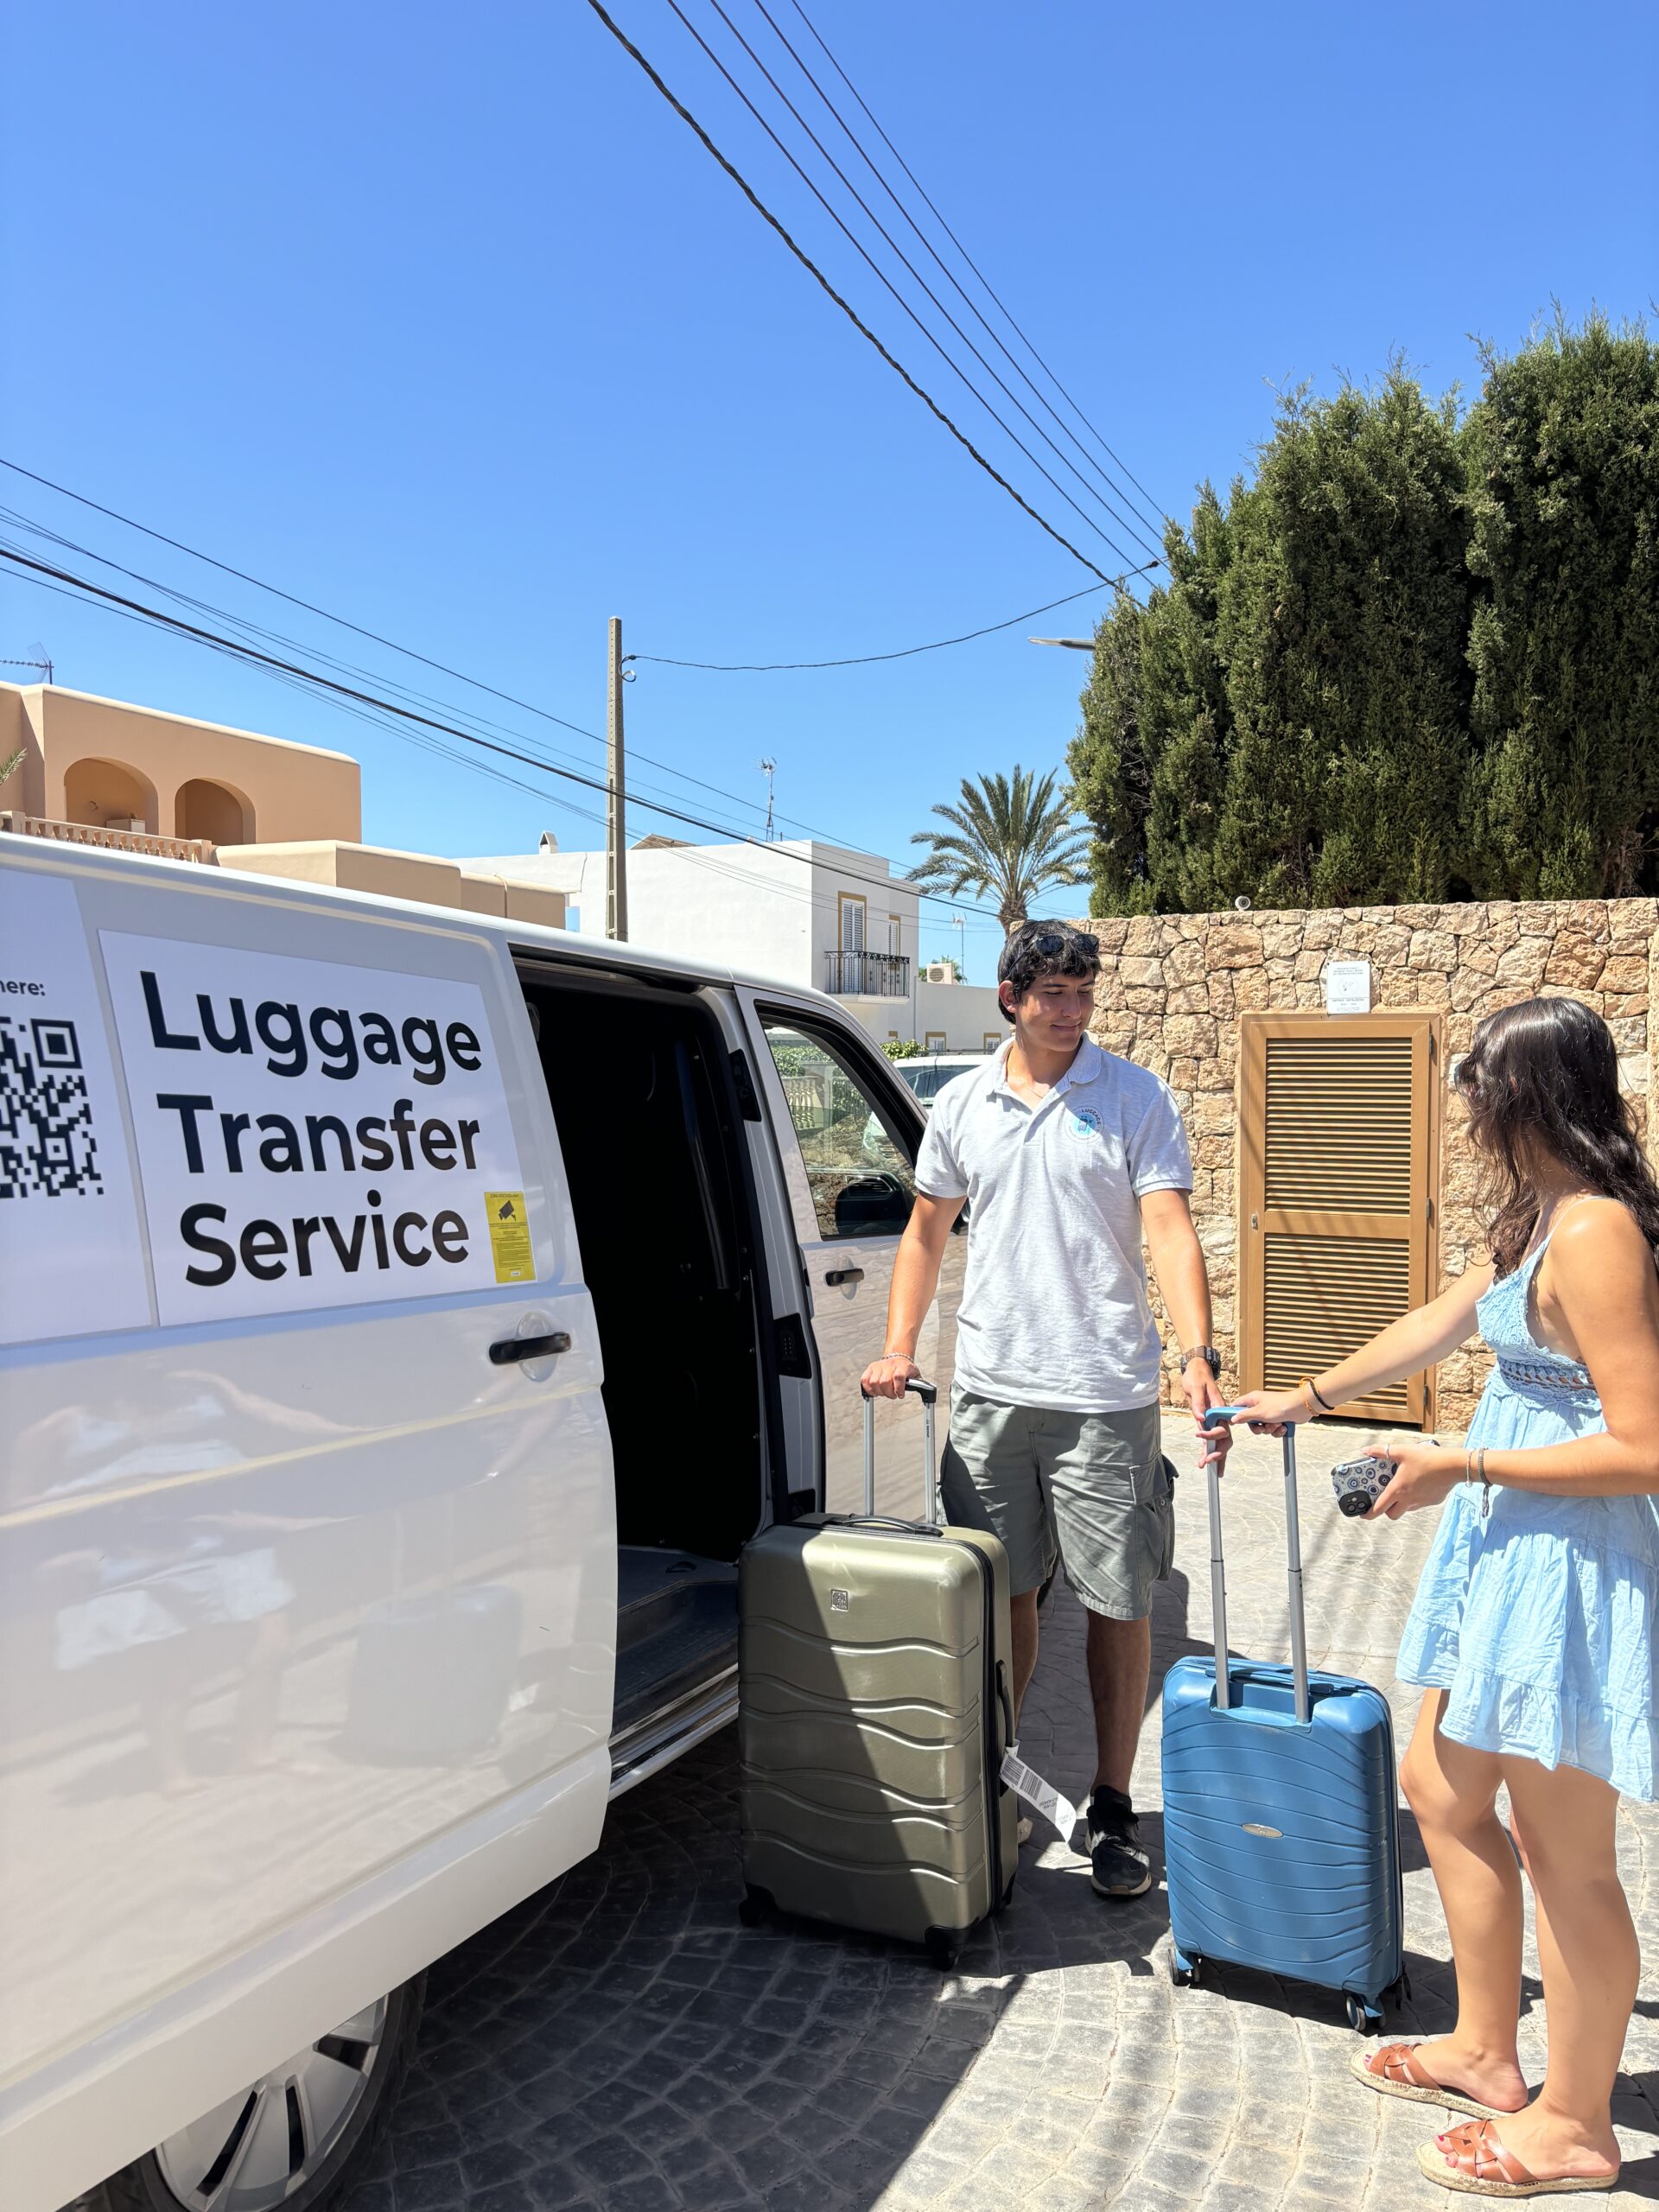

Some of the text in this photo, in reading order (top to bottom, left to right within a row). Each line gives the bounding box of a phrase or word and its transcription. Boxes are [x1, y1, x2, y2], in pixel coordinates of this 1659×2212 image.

[140, 970, 482, 1085] Luggage
[156, 1093, 480, 1173] Transfer
[180, 1189, 469, 1287] Service
